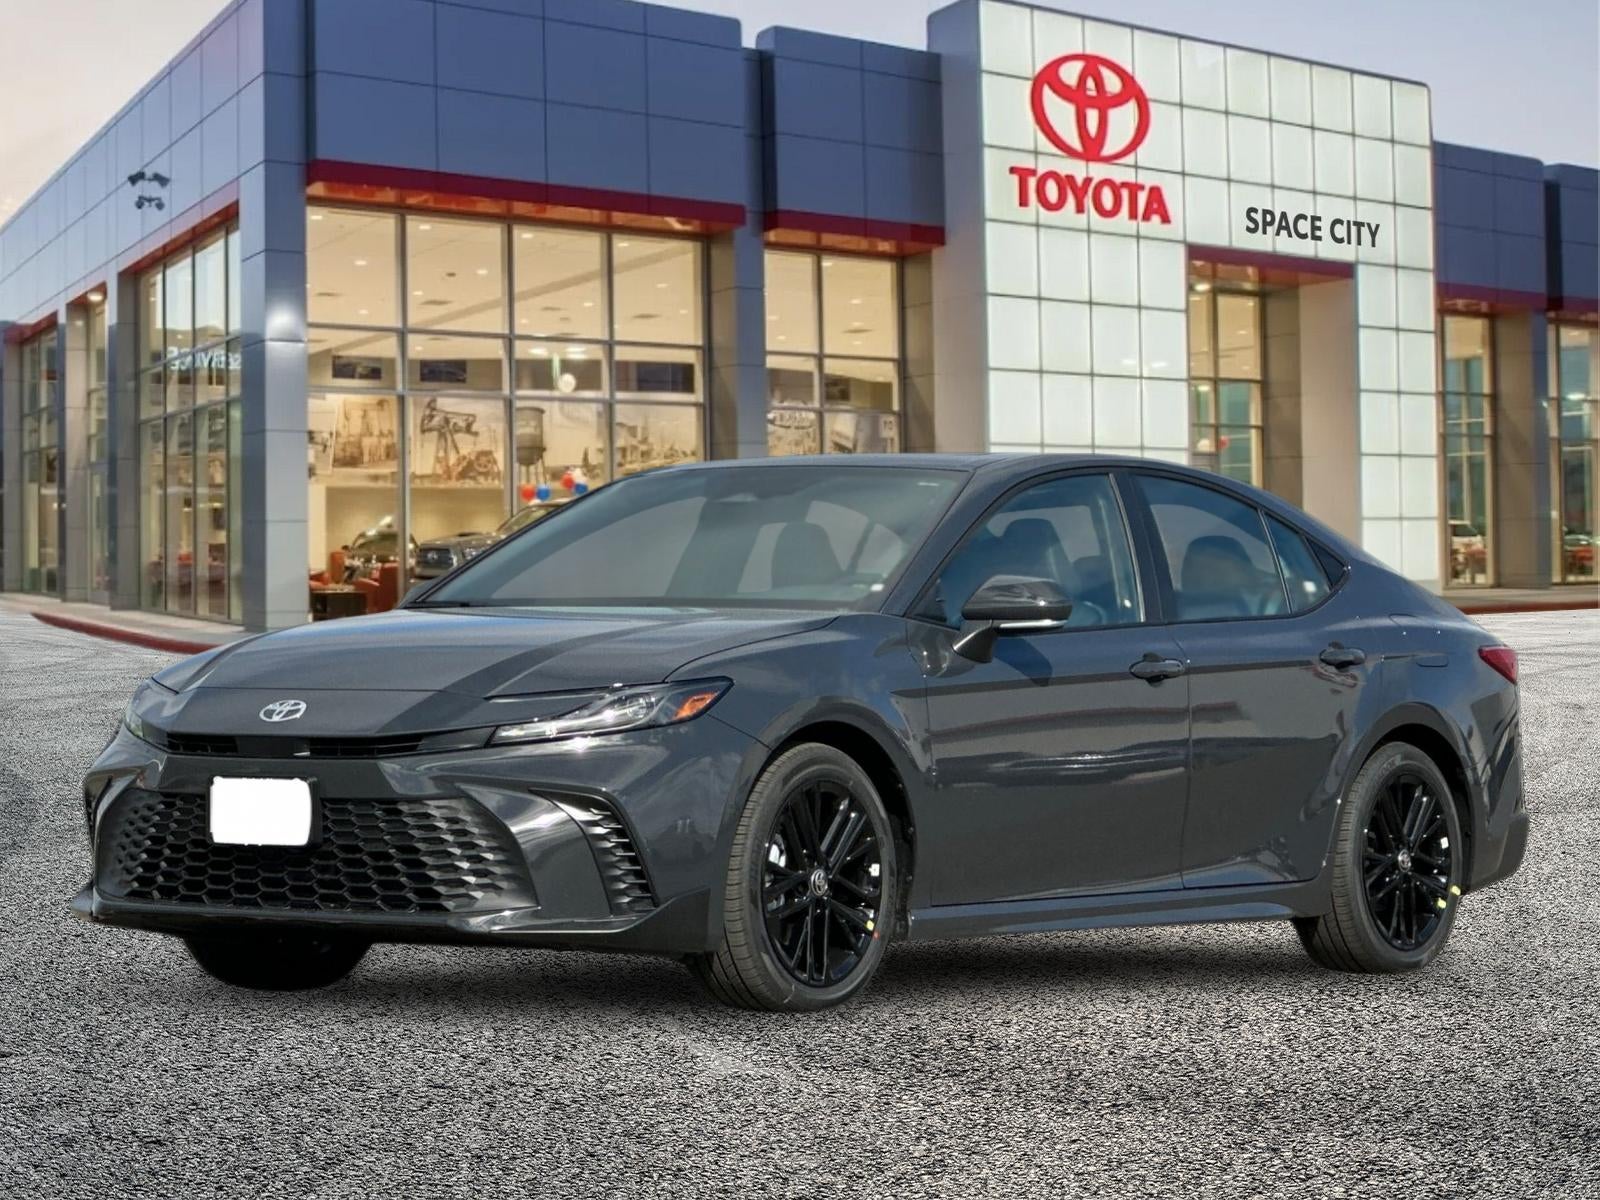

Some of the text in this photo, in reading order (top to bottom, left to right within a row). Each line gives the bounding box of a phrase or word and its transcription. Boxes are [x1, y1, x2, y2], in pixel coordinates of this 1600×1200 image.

[1009, 166, 1171, 224] TOYOTA
[1245, 206, 1381, 248] SPACE CITY
